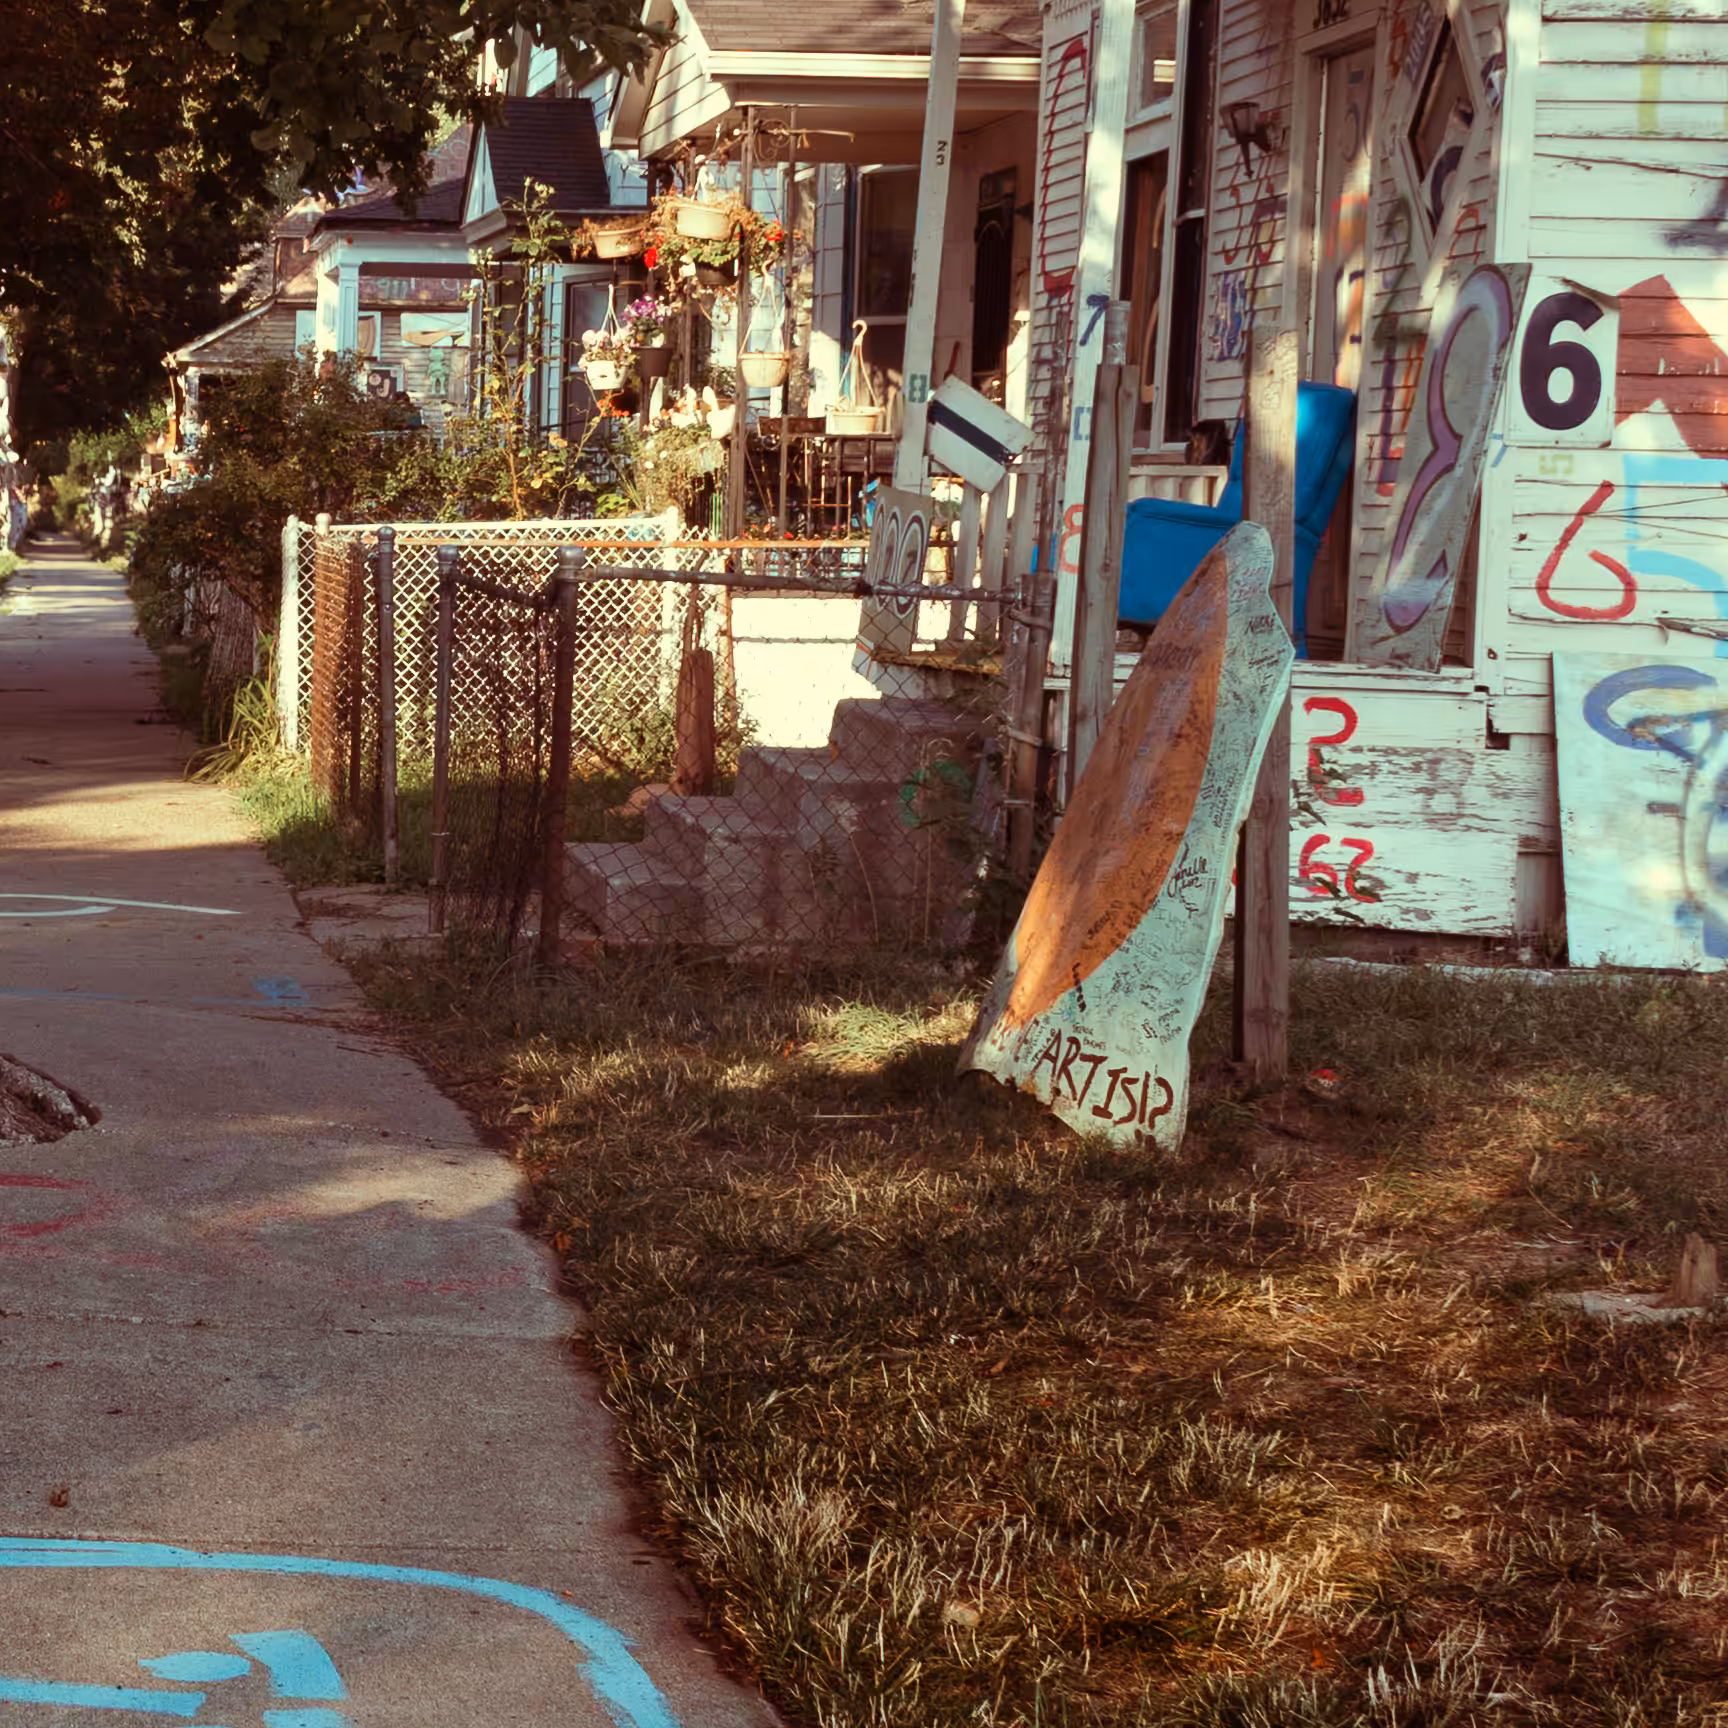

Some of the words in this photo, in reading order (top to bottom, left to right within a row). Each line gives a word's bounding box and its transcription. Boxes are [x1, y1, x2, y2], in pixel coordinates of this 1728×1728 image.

[1519, 291, 1605, 431] 6
[1535, 480, 1638, 621] 6
[1298, 833, 1381, 904] 62
